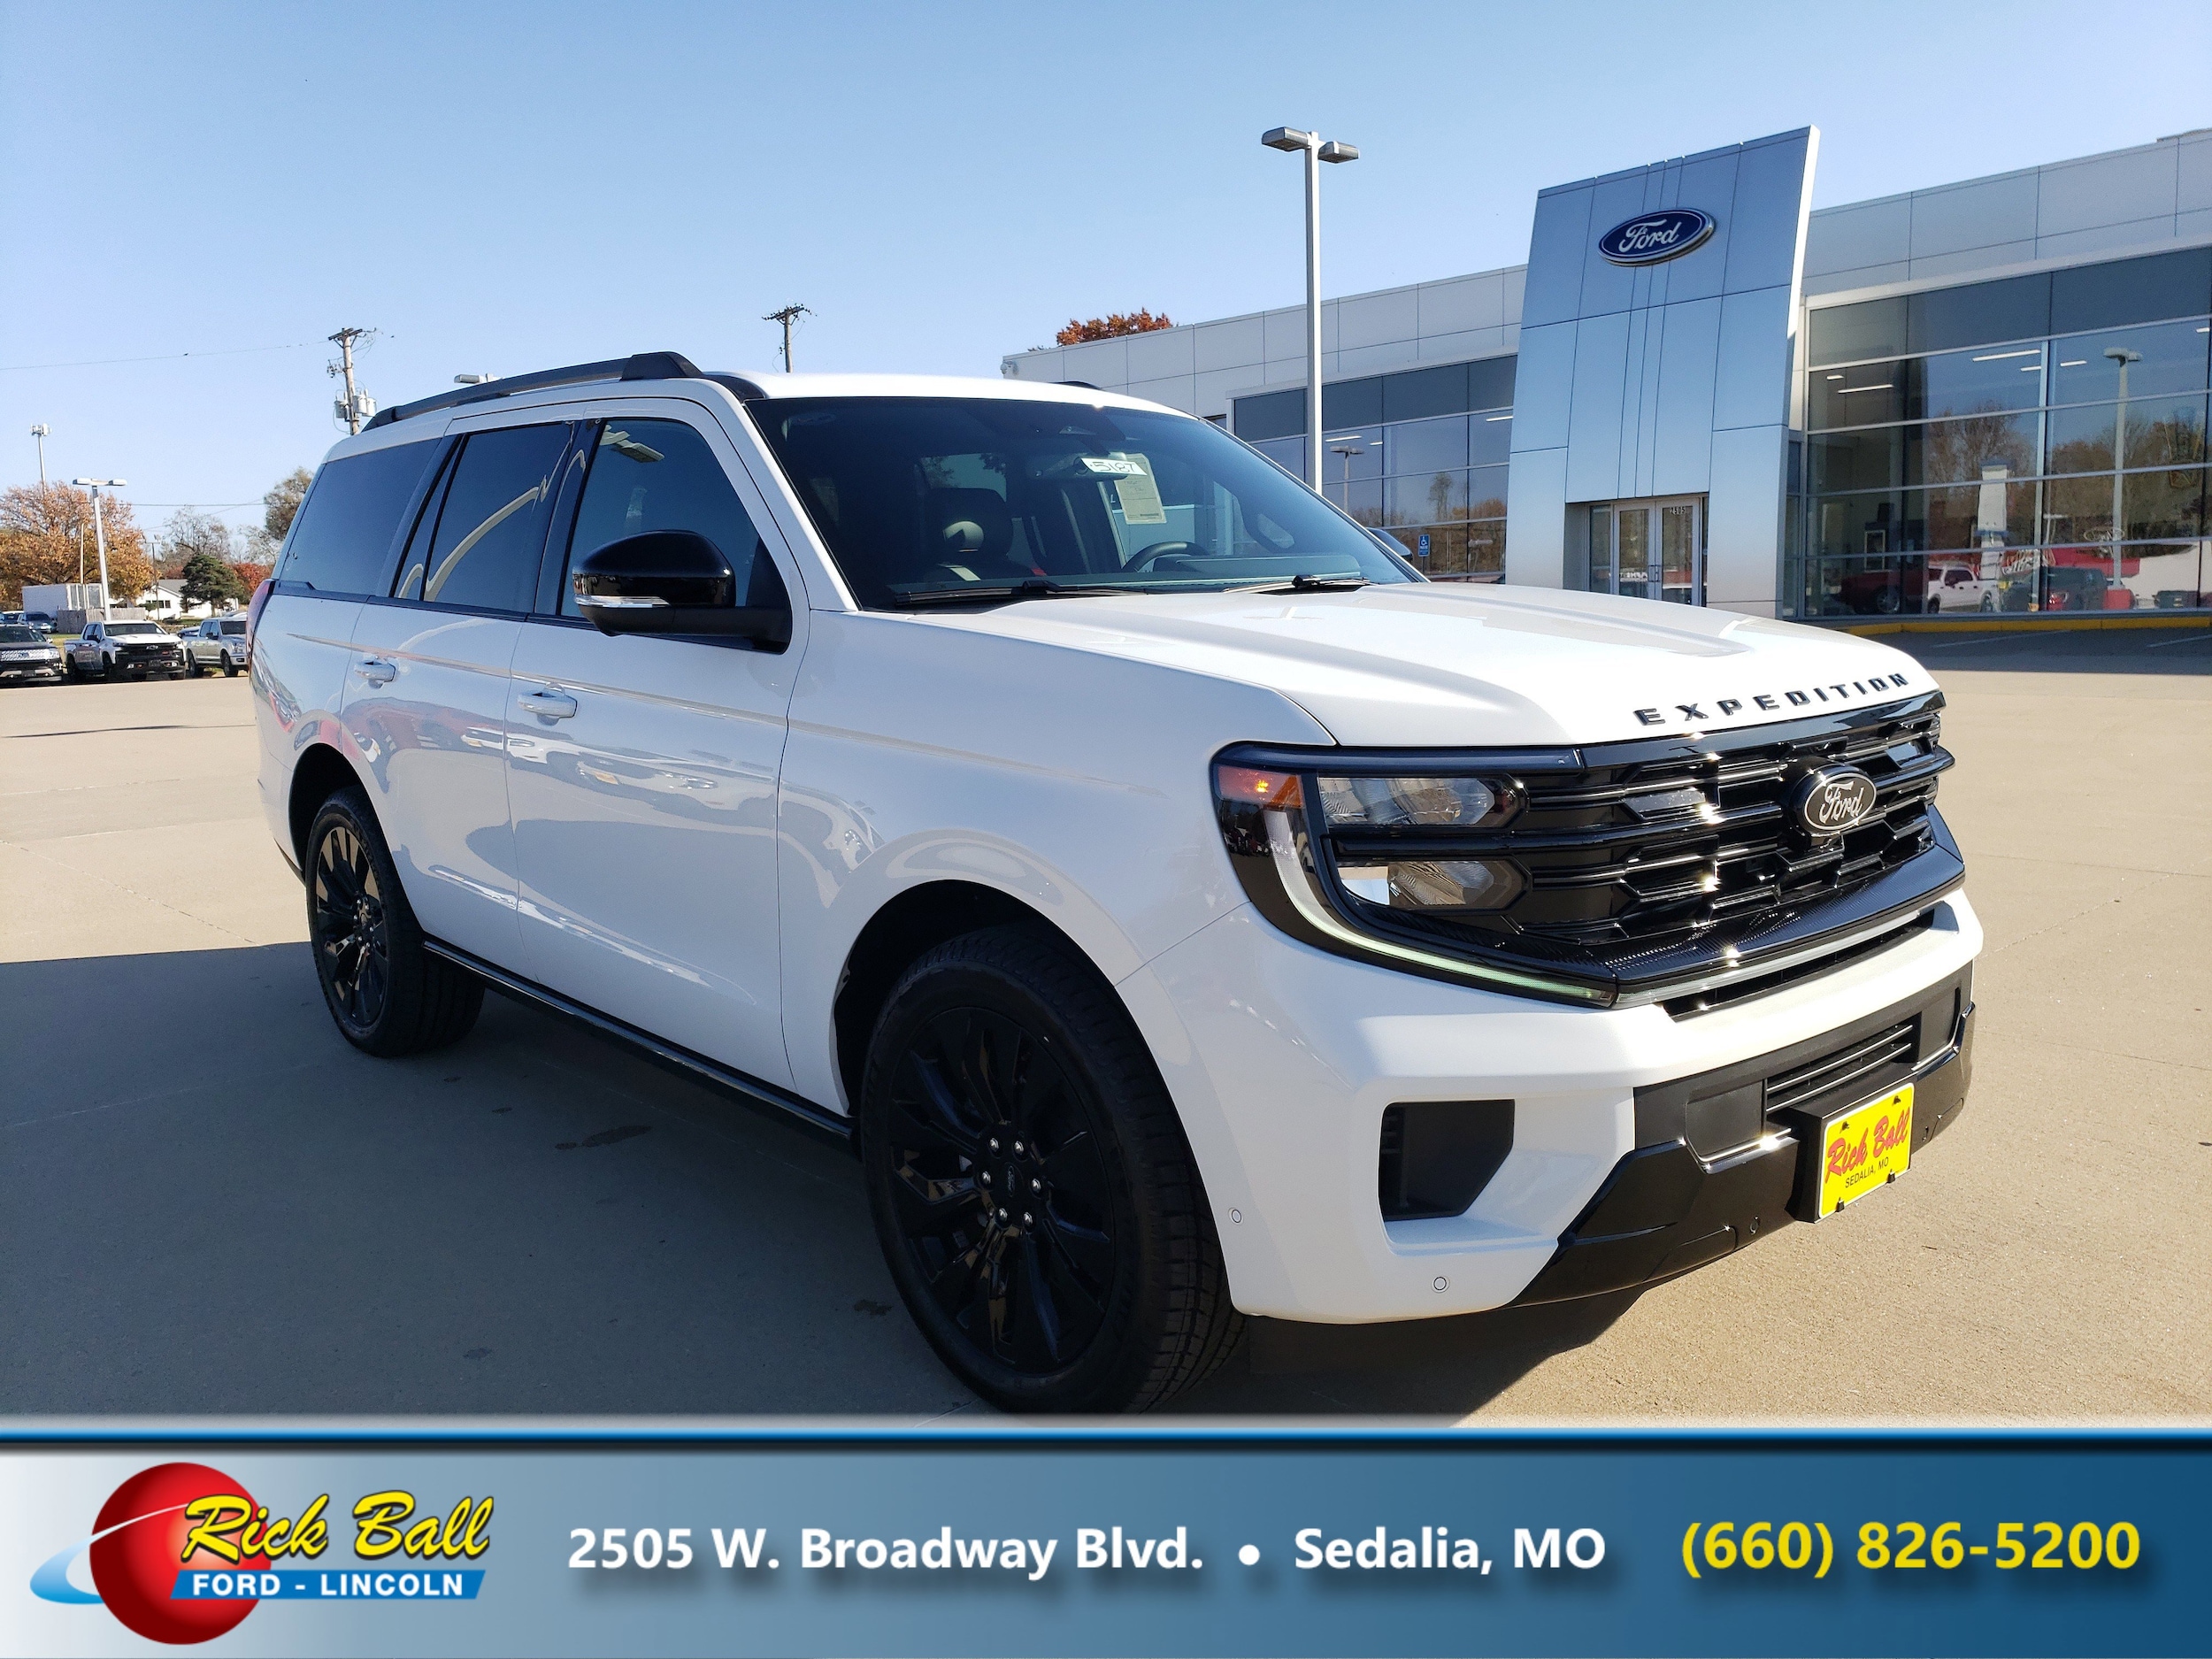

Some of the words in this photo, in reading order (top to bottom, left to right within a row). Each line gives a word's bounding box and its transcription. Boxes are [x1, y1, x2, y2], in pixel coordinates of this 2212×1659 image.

[1618, 219, 1682, 253] Ford
[1633, 672, 1909, 726] EXPEDITION
[1819, 780, 1864, 824] Ford
[1824, 1127, 1869, 1184] Rick
[1873, 1107, 1911, 1158] Ball
[1845, 1164, 1876, 1188] SEDALIA,
[1878, 1156, 1889, 1171] MO
